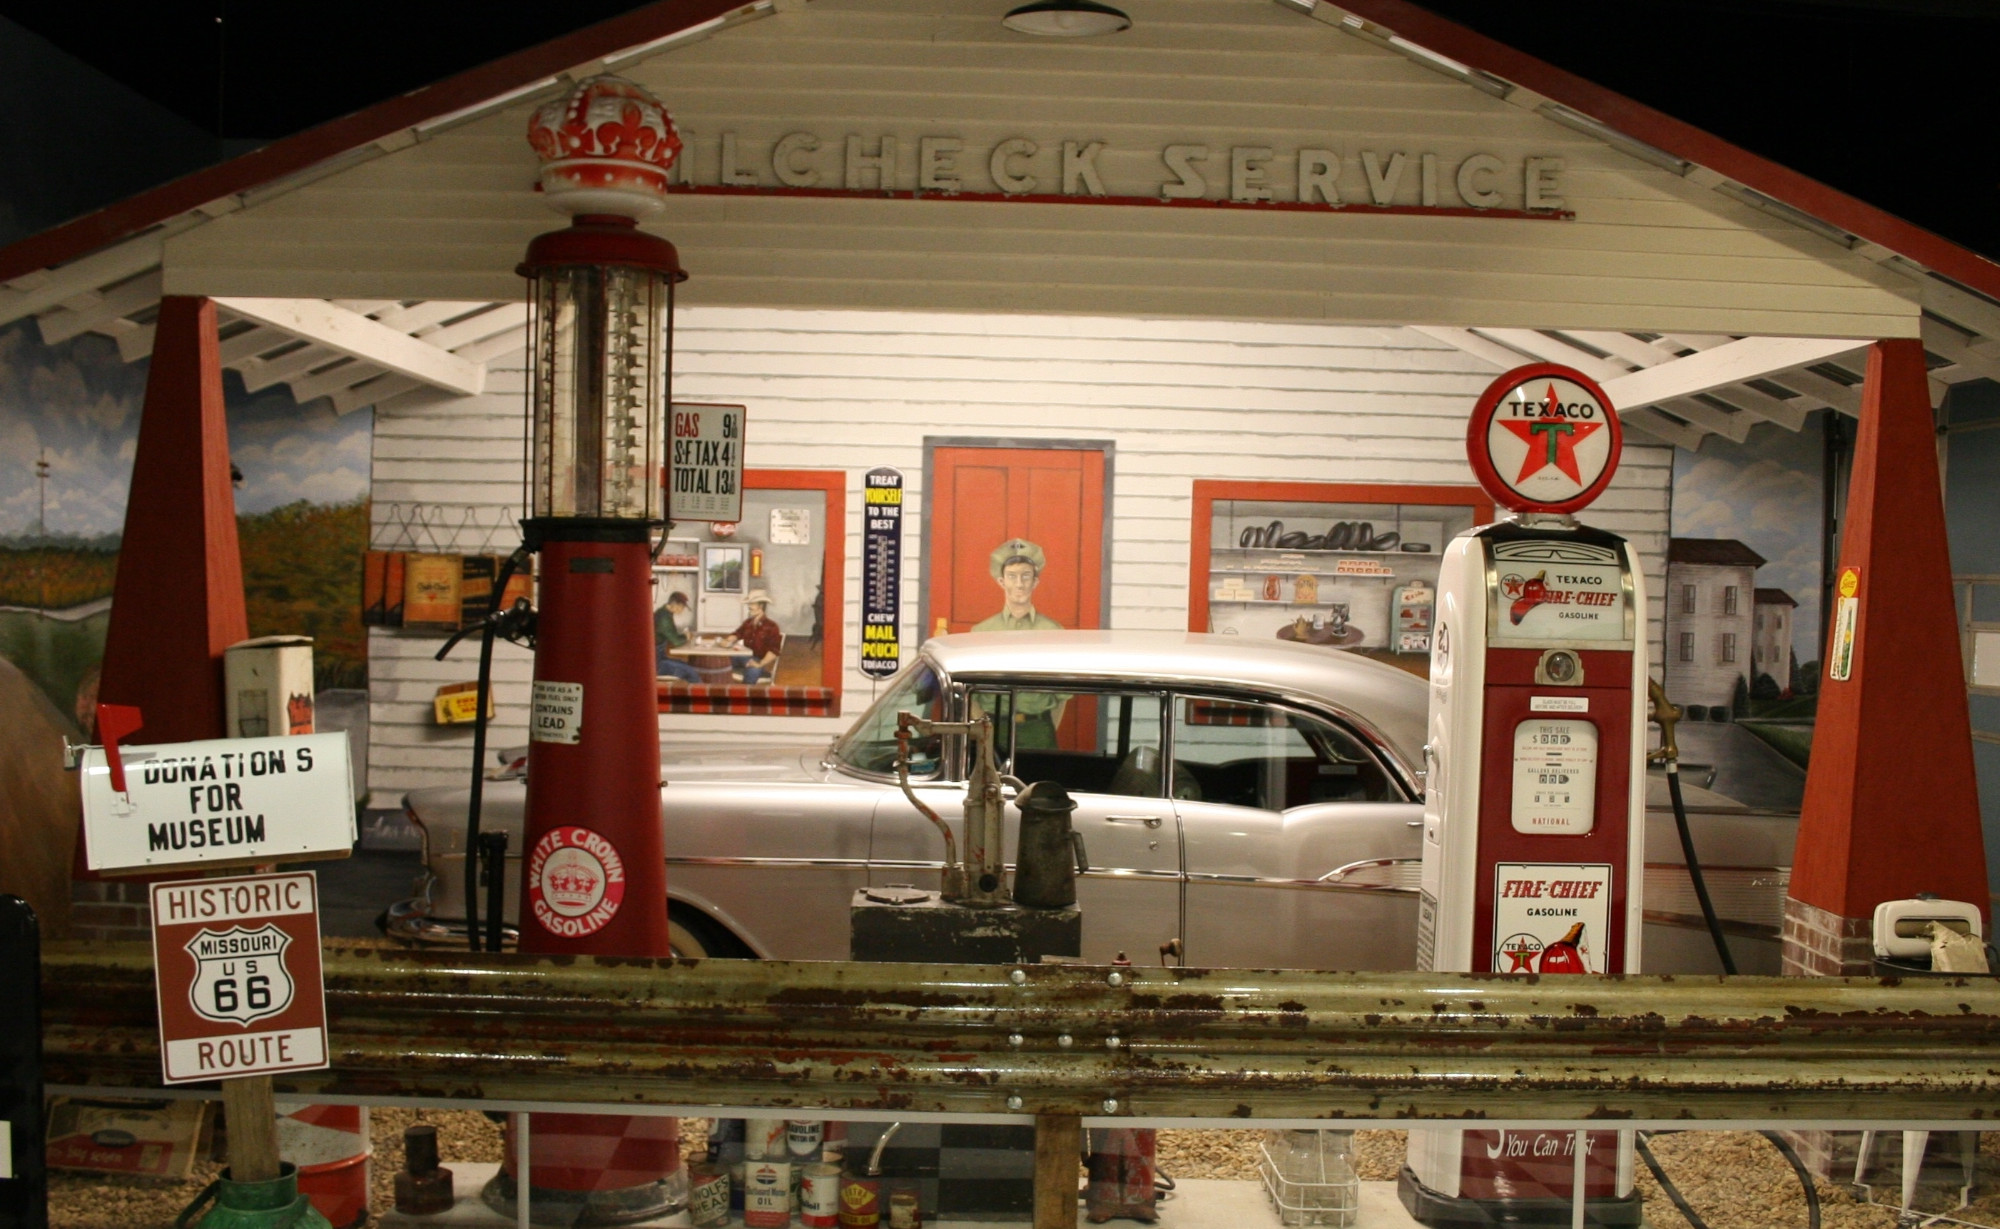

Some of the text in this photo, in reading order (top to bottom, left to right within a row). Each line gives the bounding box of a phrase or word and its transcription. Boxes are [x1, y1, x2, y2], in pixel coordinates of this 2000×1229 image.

[678, 130, 1567, 213] ILCHECK SERVICE
[1508, 402, 1594, 419] TEXACO
[675, 412, 700, 438] GAS
[723, 414, 732, 438] 9
[694, 441, 720, 466] TAX
[721, 442, 730, 467] 4
[674, 467, 711, 494] TOTAL
[715, 469, 729, 495] 13
[870, 475, 898, 486] TREAT
[868, 506, 899, 517] TO THE
[870, 519, 895, 530] BEST
[1556, 575, 1602, 585] TEXACO
[867, 613, 895, 623] CHEW
[1558, 612, 1599, 620] GASOLINE
[864, 625, 896, 640] MAIL
[862, 643, 898, 658] POUCH
[863, 660, 897, 669] TOBACCO
[535, 704, 573, 715] CONTAINS
[538, 717, 565, 729] LEAD
[190, 783, 243, 814] FOR
[149, 814, 265, 851] MUSEUM
[530, 829, 624, 889] WHITE CROWN
[1501, 880, 1603, 899] FIRE-CHIEF
[169, 881, 301, 920] HISTORIC
[534, 898, 618, 937] GASOLINE
[1527, 908, 1578, 917] GASOLINE
[200, 935, 278, 956] MISSOURI
[1506, 943, 1541, 951] TEXACO
[214, 976, 271, 1013] 66
[198, 1034, 294, 1070] ROUTE
[1506, 1134, 1528, 1157] You
[1533, 1133, 1558, 1157] Can
[1563, 1133, 1596, 1156] Trst
[757, 1197, 773, 1206] OIL
